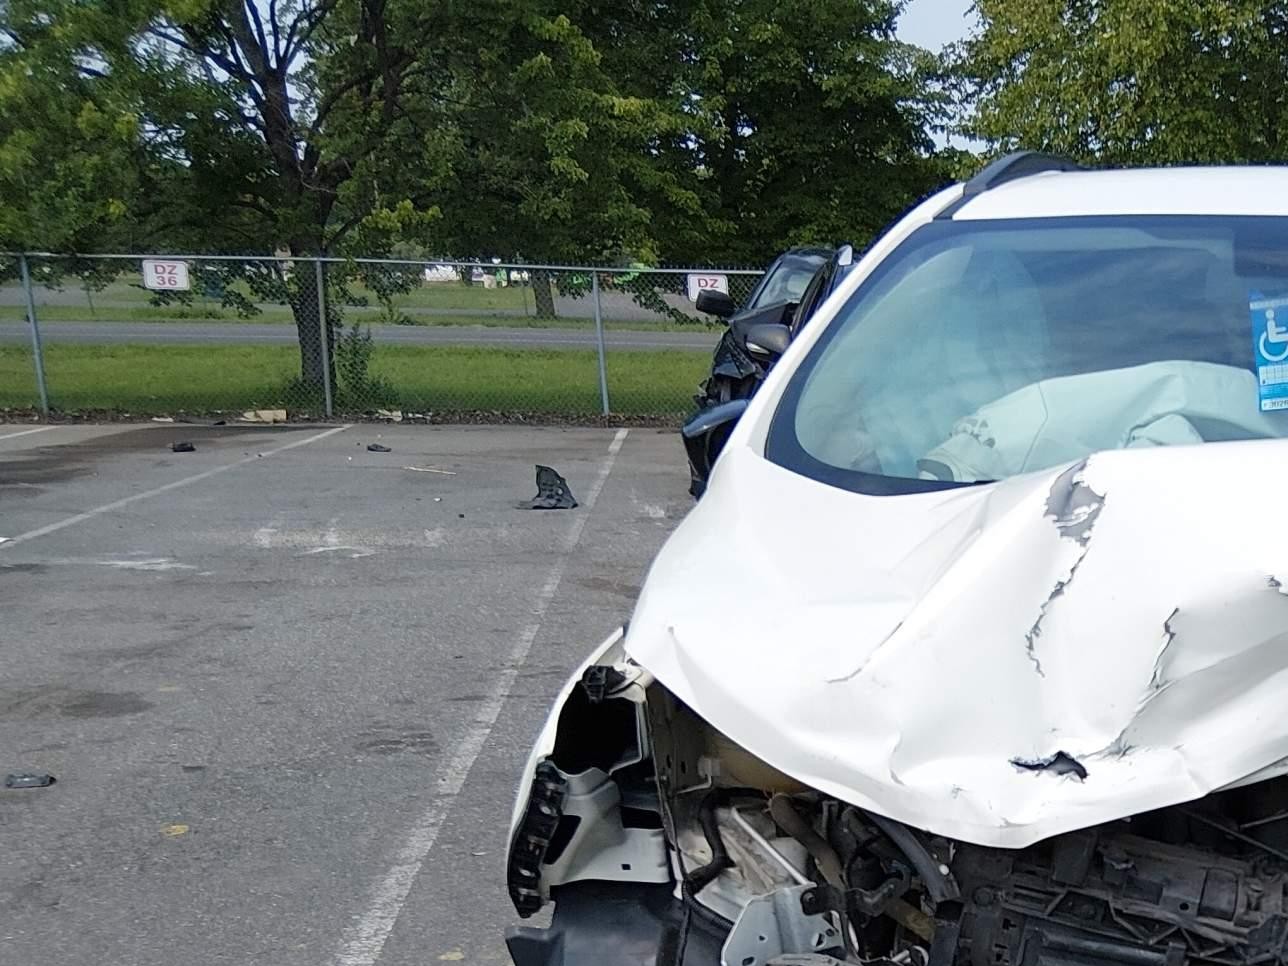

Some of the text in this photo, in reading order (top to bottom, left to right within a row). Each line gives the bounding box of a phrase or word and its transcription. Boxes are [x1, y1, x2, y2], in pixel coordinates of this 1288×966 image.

[154, 264, 177, 275] DZ
[156, 275, 177, 286] 36
[697, 278, 719, 288] DZ
